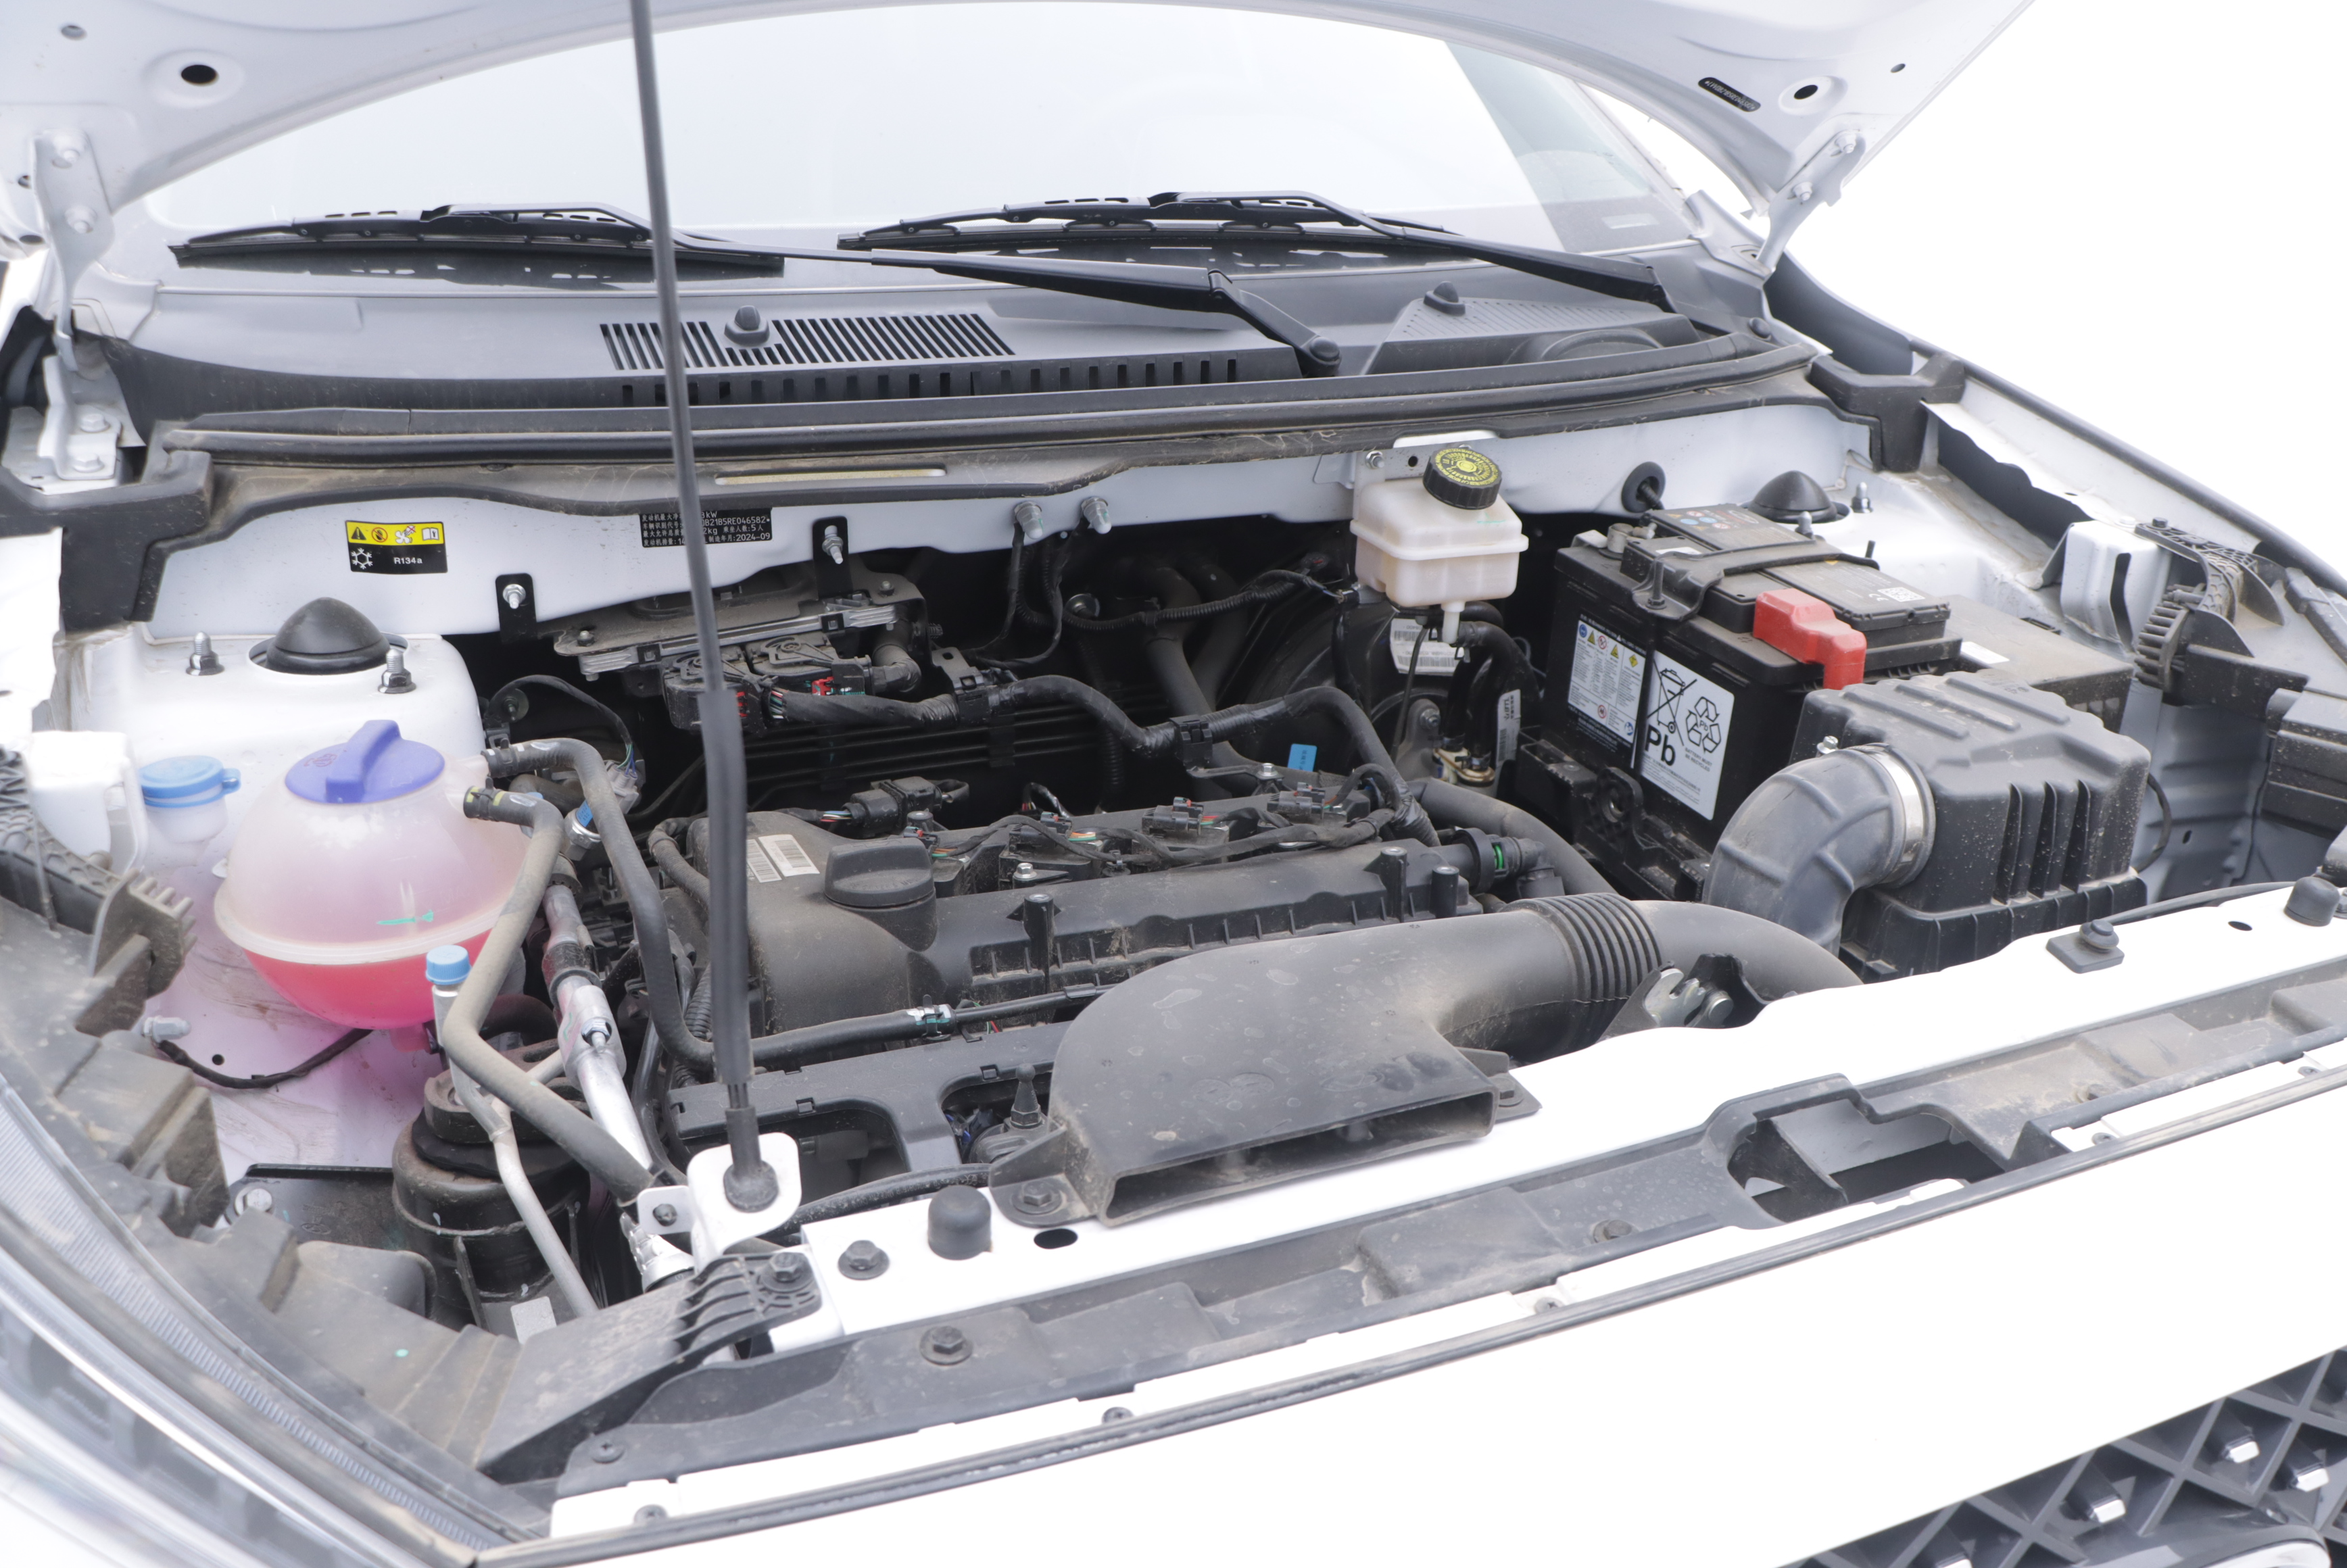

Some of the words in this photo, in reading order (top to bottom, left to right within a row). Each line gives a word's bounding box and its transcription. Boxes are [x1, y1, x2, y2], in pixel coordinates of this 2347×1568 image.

[642, 513, 682, 522] 发动机最大净
[703, 527, 718, 535] 2kg
[644, 537, 685, 547] 发动机排量:14
[1699, 720, 1708, 731] Pb
[1645, 724, 1676, 766] Pb
[1685, 747, 1701, 760] BATTERY
[1702, 758, 1712, 766] MUST
[1691, 757, 1710, 772] RECYCLED
